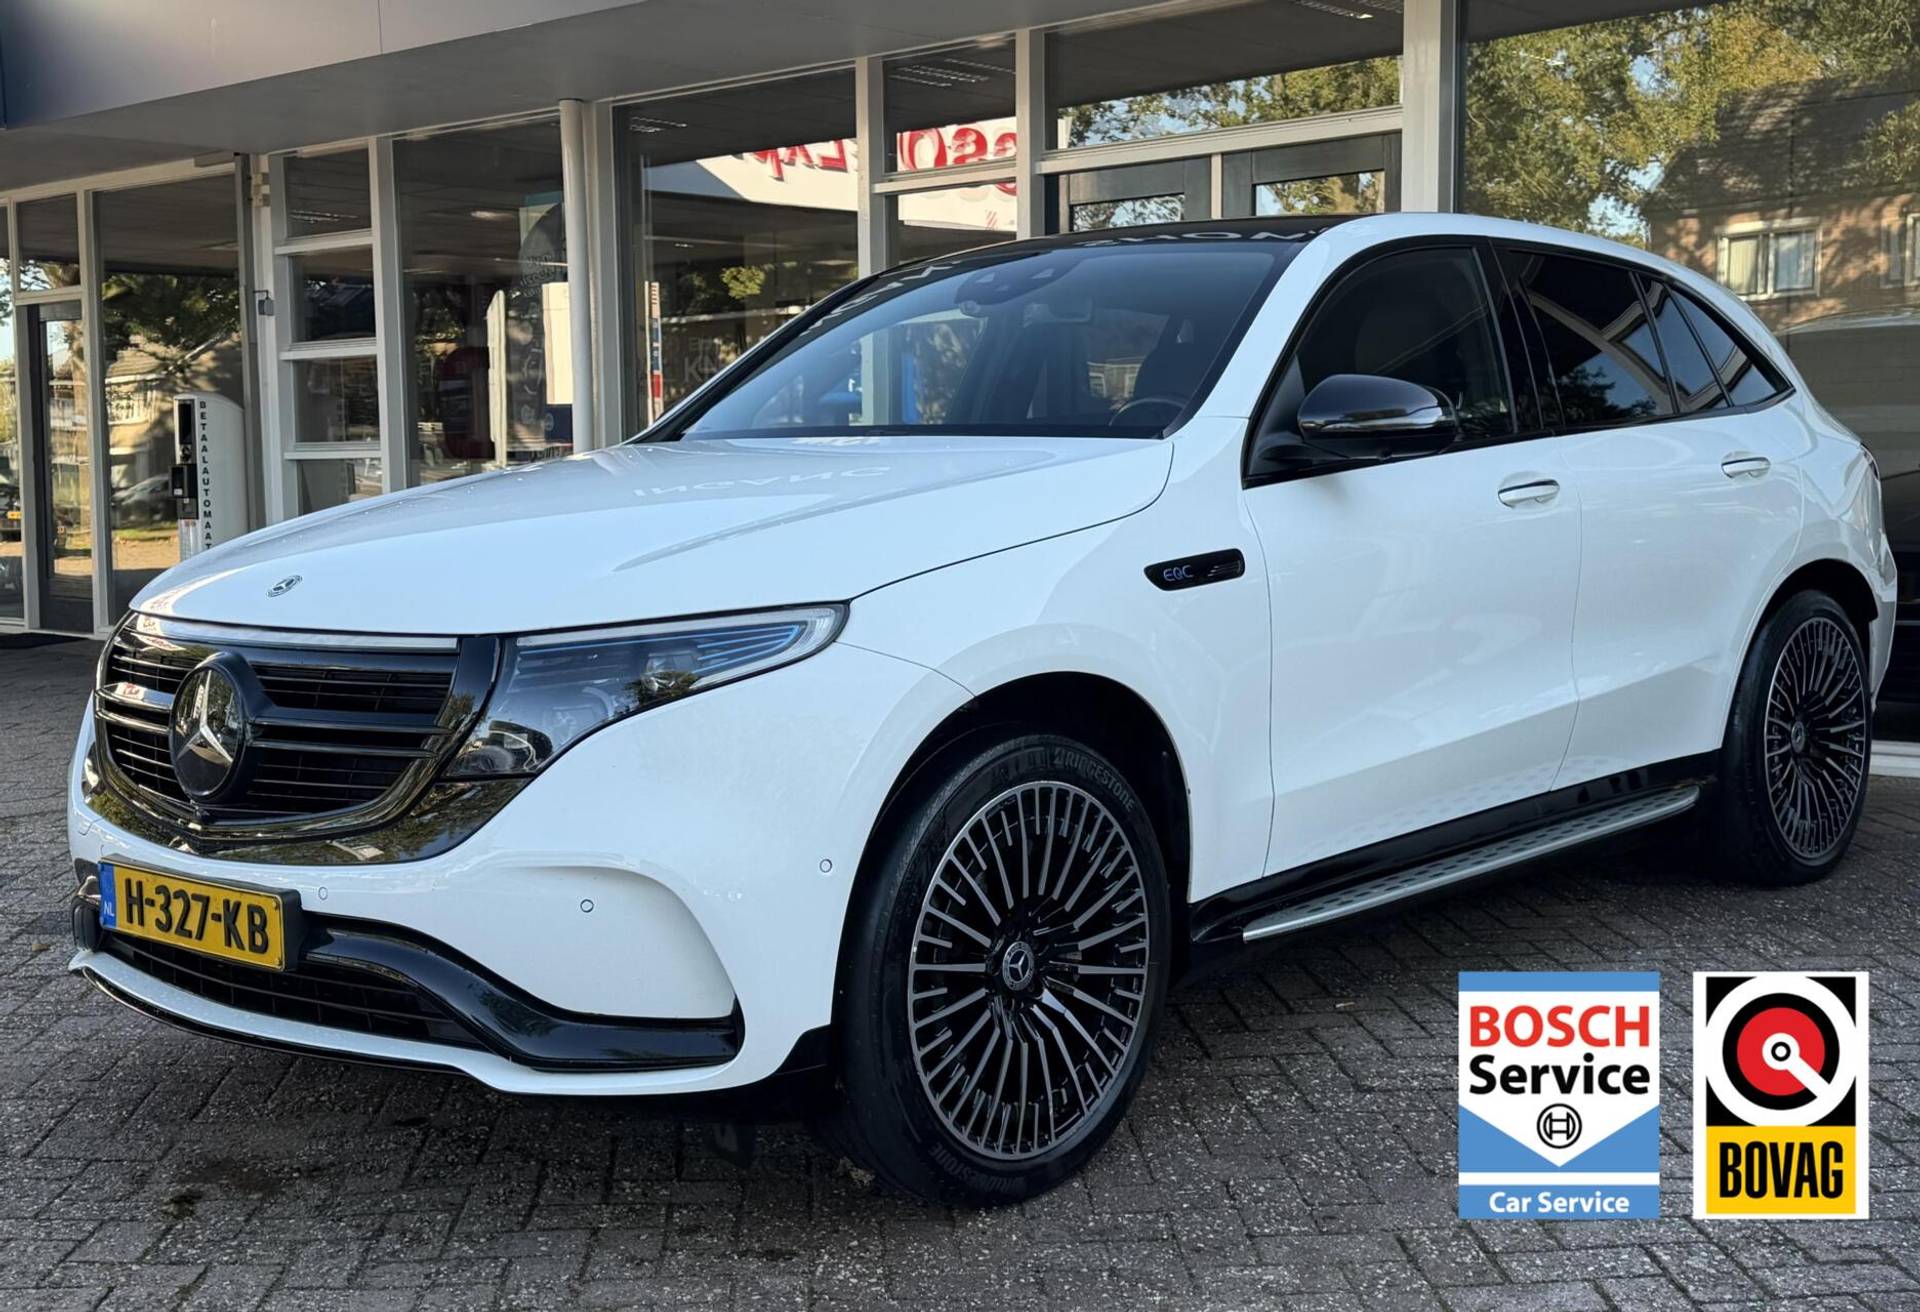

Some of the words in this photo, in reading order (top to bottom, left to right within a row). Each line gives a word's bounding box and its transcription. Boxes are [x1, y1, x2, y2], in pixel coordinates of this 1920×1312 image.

[199, 401, 212, 550] BETAALAUTOMAAT
[1163, 565, 1194, 582] EQC
[1053, 747, 1135, 812] BRIDGESTONE
[103, 902, 115, 918] NL
[124, 878, 269, 954] H-327-KB
